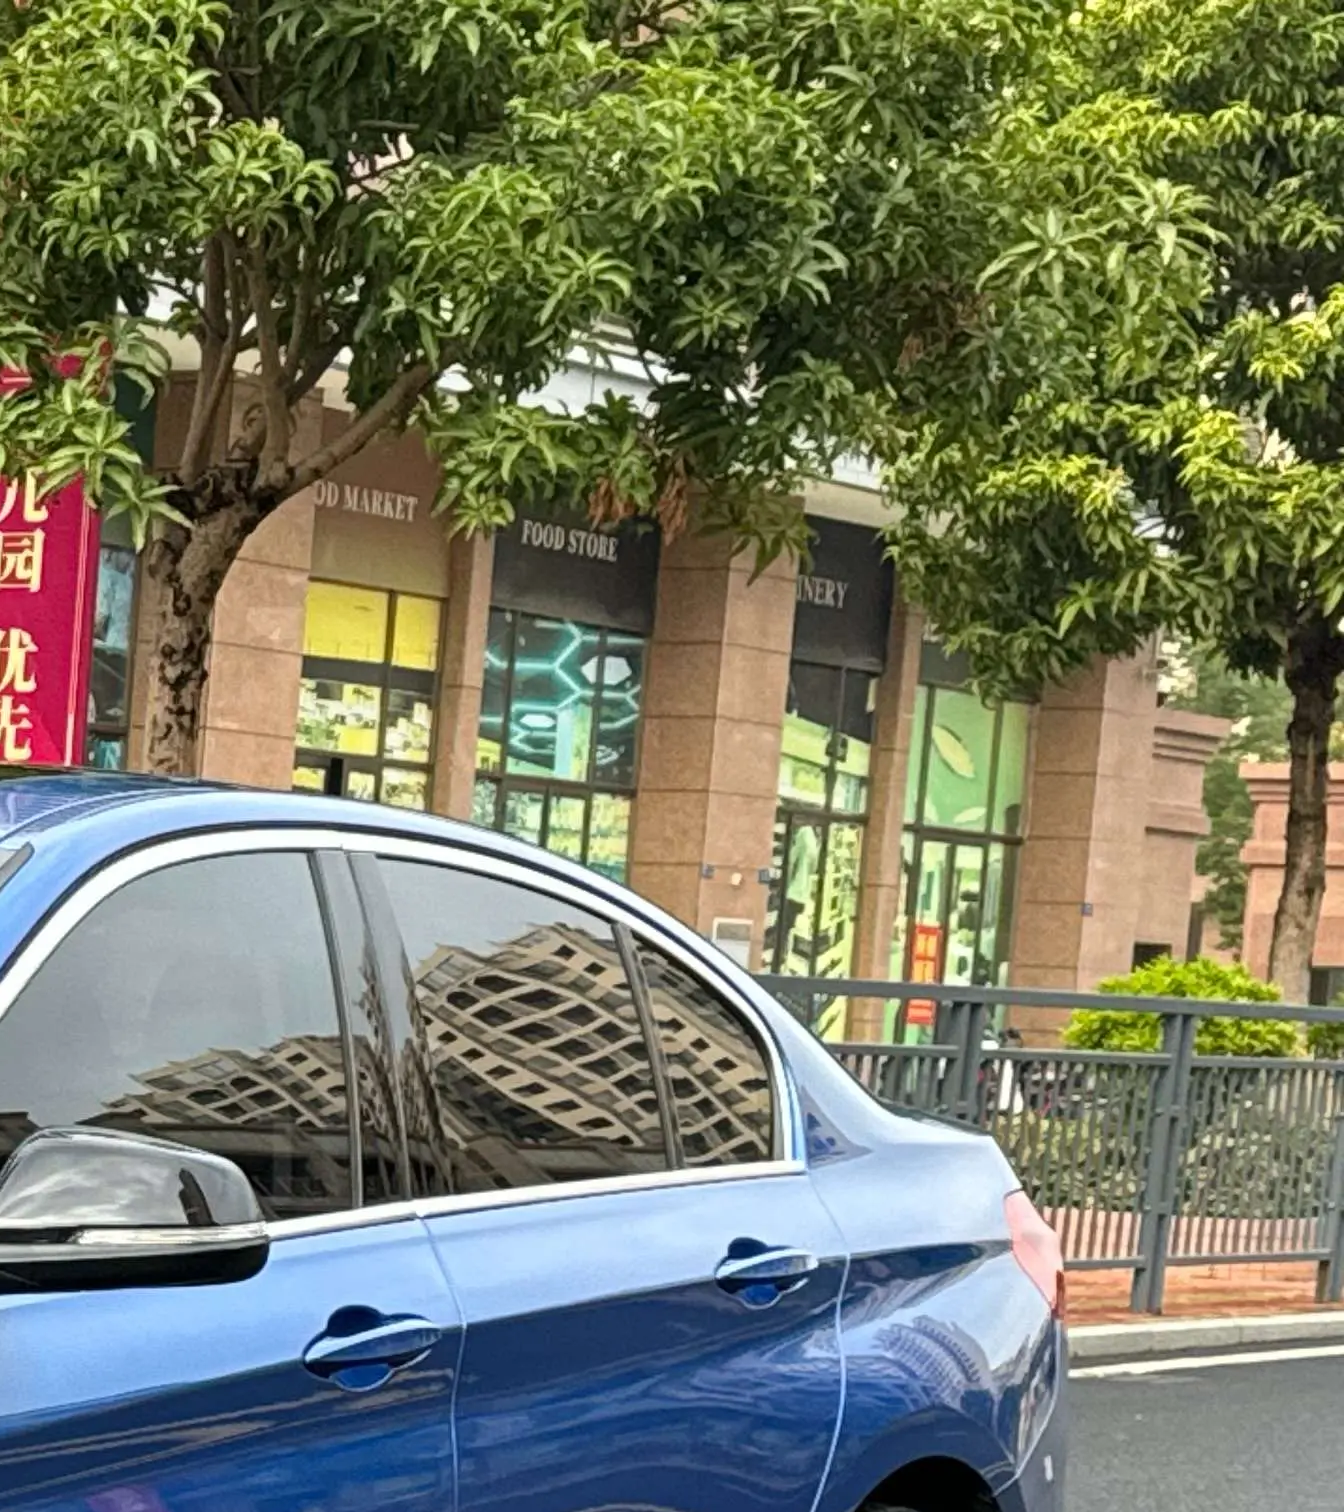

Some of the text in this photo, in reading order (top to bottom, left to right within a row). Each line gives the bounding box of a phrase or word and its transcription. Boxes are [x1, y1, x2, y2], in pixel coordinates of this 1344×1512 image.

[342, 484, 418, 522] MARKET
[521, 519, 619, 562] FOOD STORE
